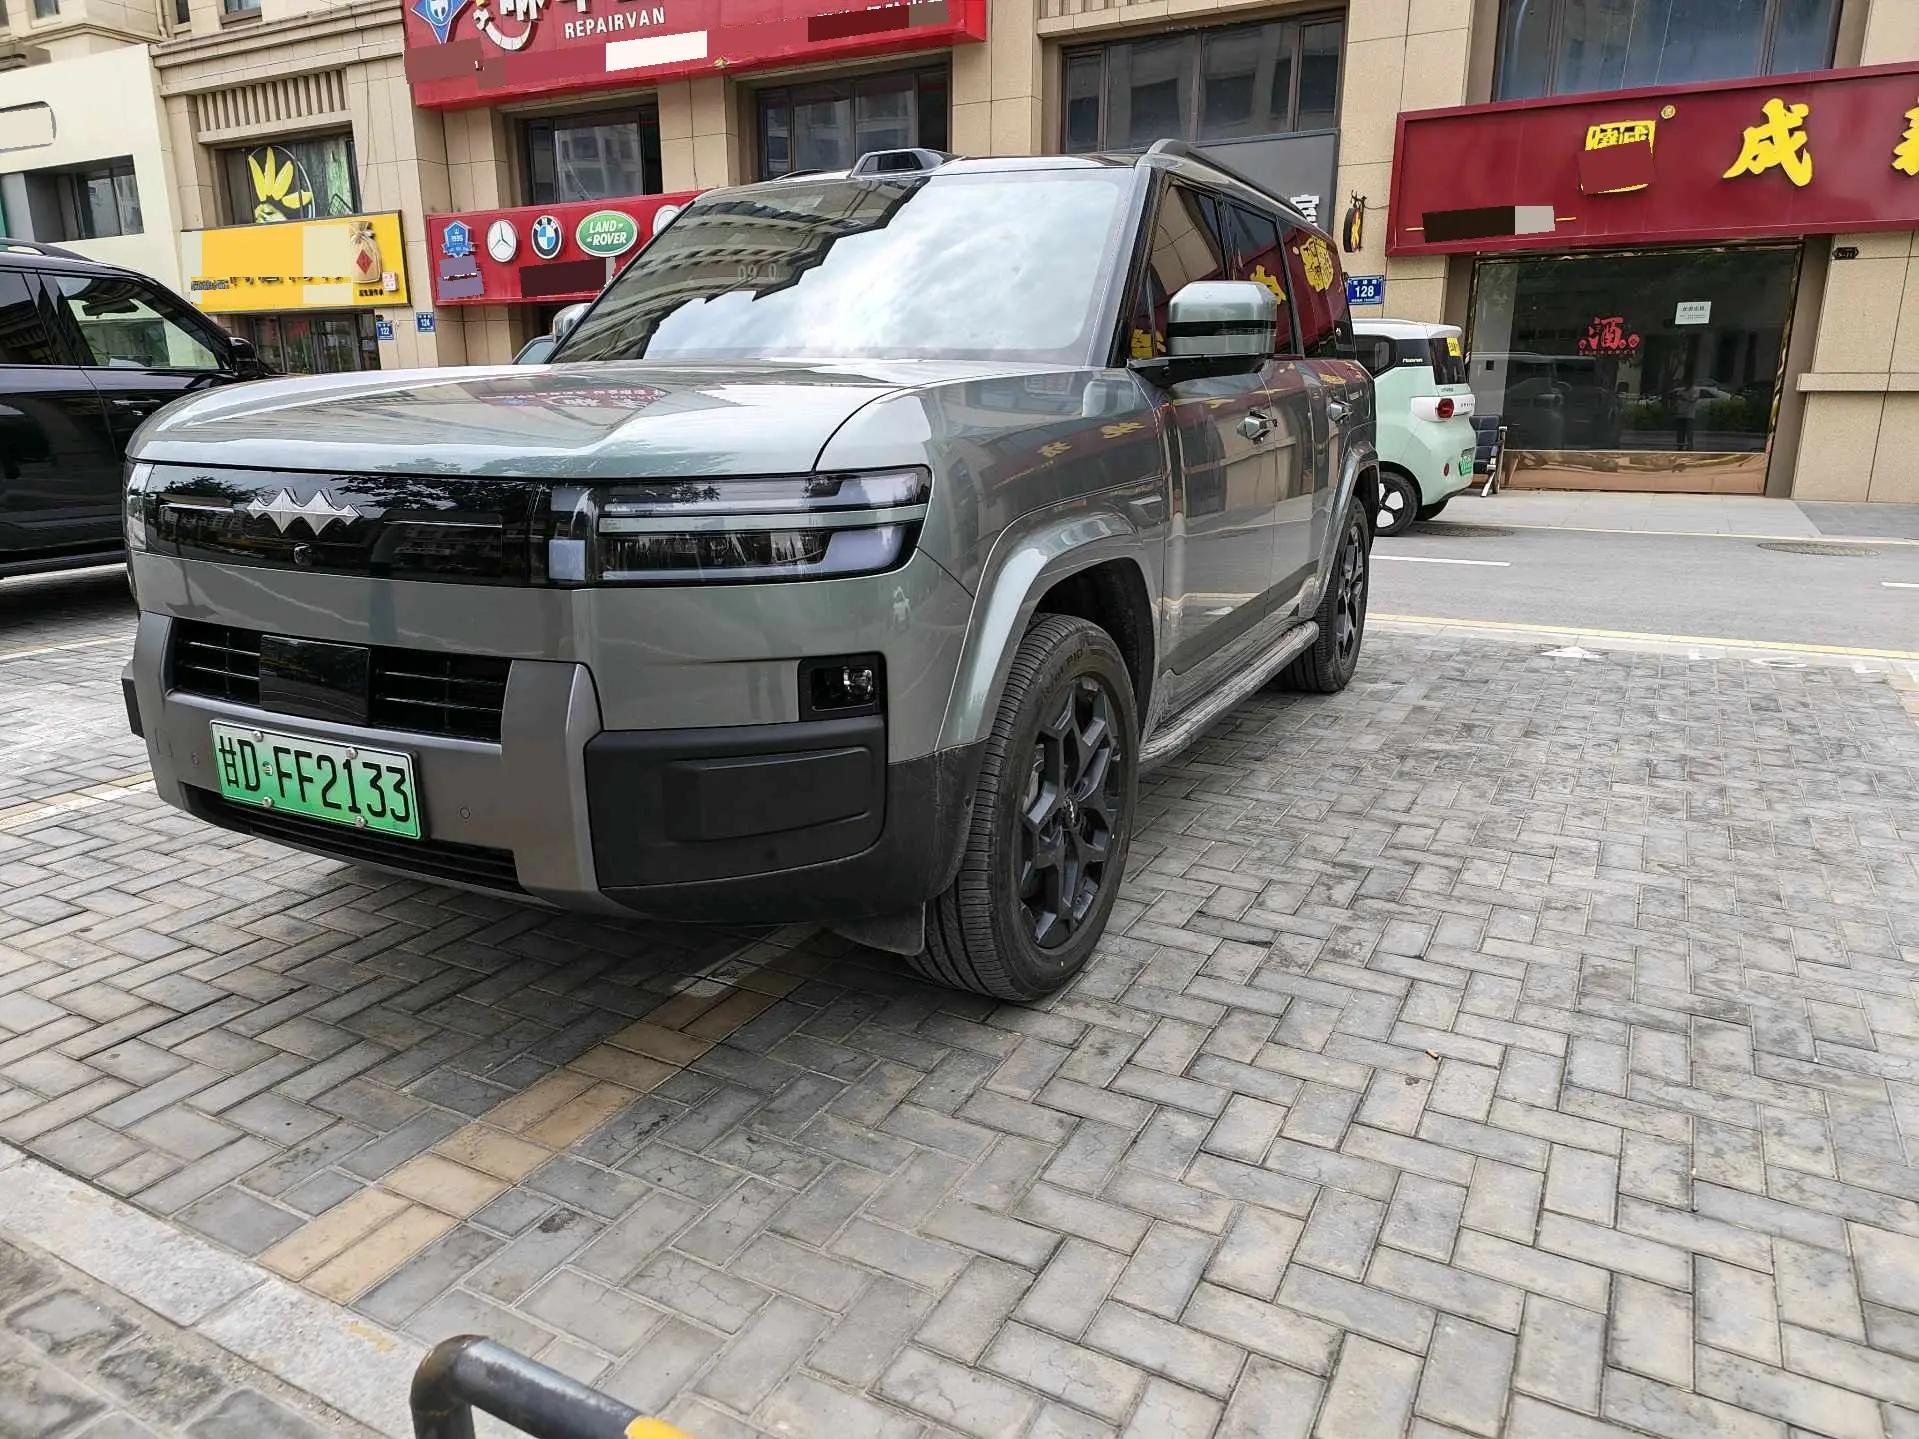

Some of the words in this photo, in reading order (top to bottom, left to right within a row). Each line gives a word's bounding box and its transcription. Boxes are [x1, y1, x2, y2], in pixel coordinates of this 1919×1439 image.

[589, 220, 617, 233] LAND
[592, 231, 627, 246] ROVER
[1355, 285, 1374, 298] 128
[1588, 316, 1624, 349] 酒
